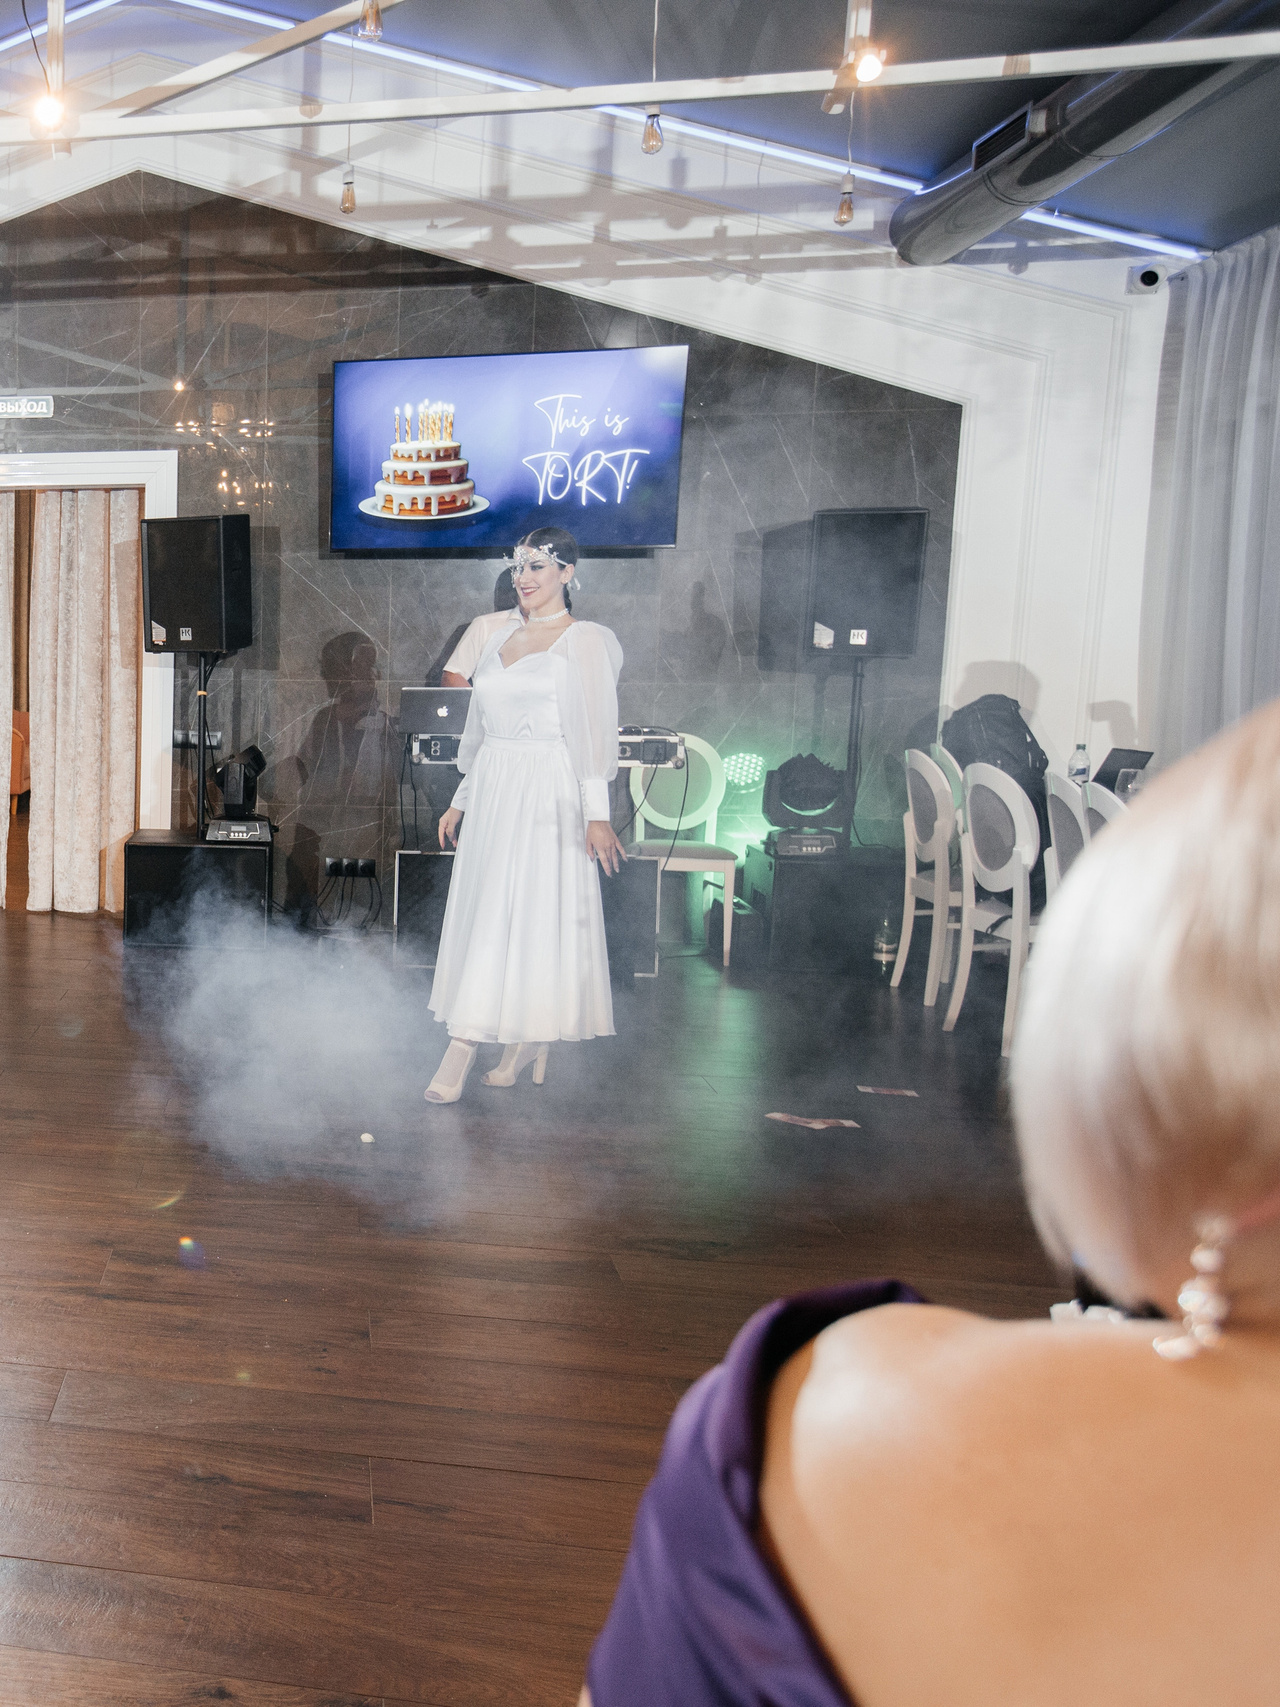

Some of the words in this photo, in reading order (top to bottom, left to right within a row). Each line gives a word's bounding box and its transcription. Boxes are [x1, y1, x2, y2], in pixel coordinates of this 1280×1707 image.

[534, 394, 596, 448] This
[605, 408, 629, 436] is
[522, 449, 651, 506] TORT!
